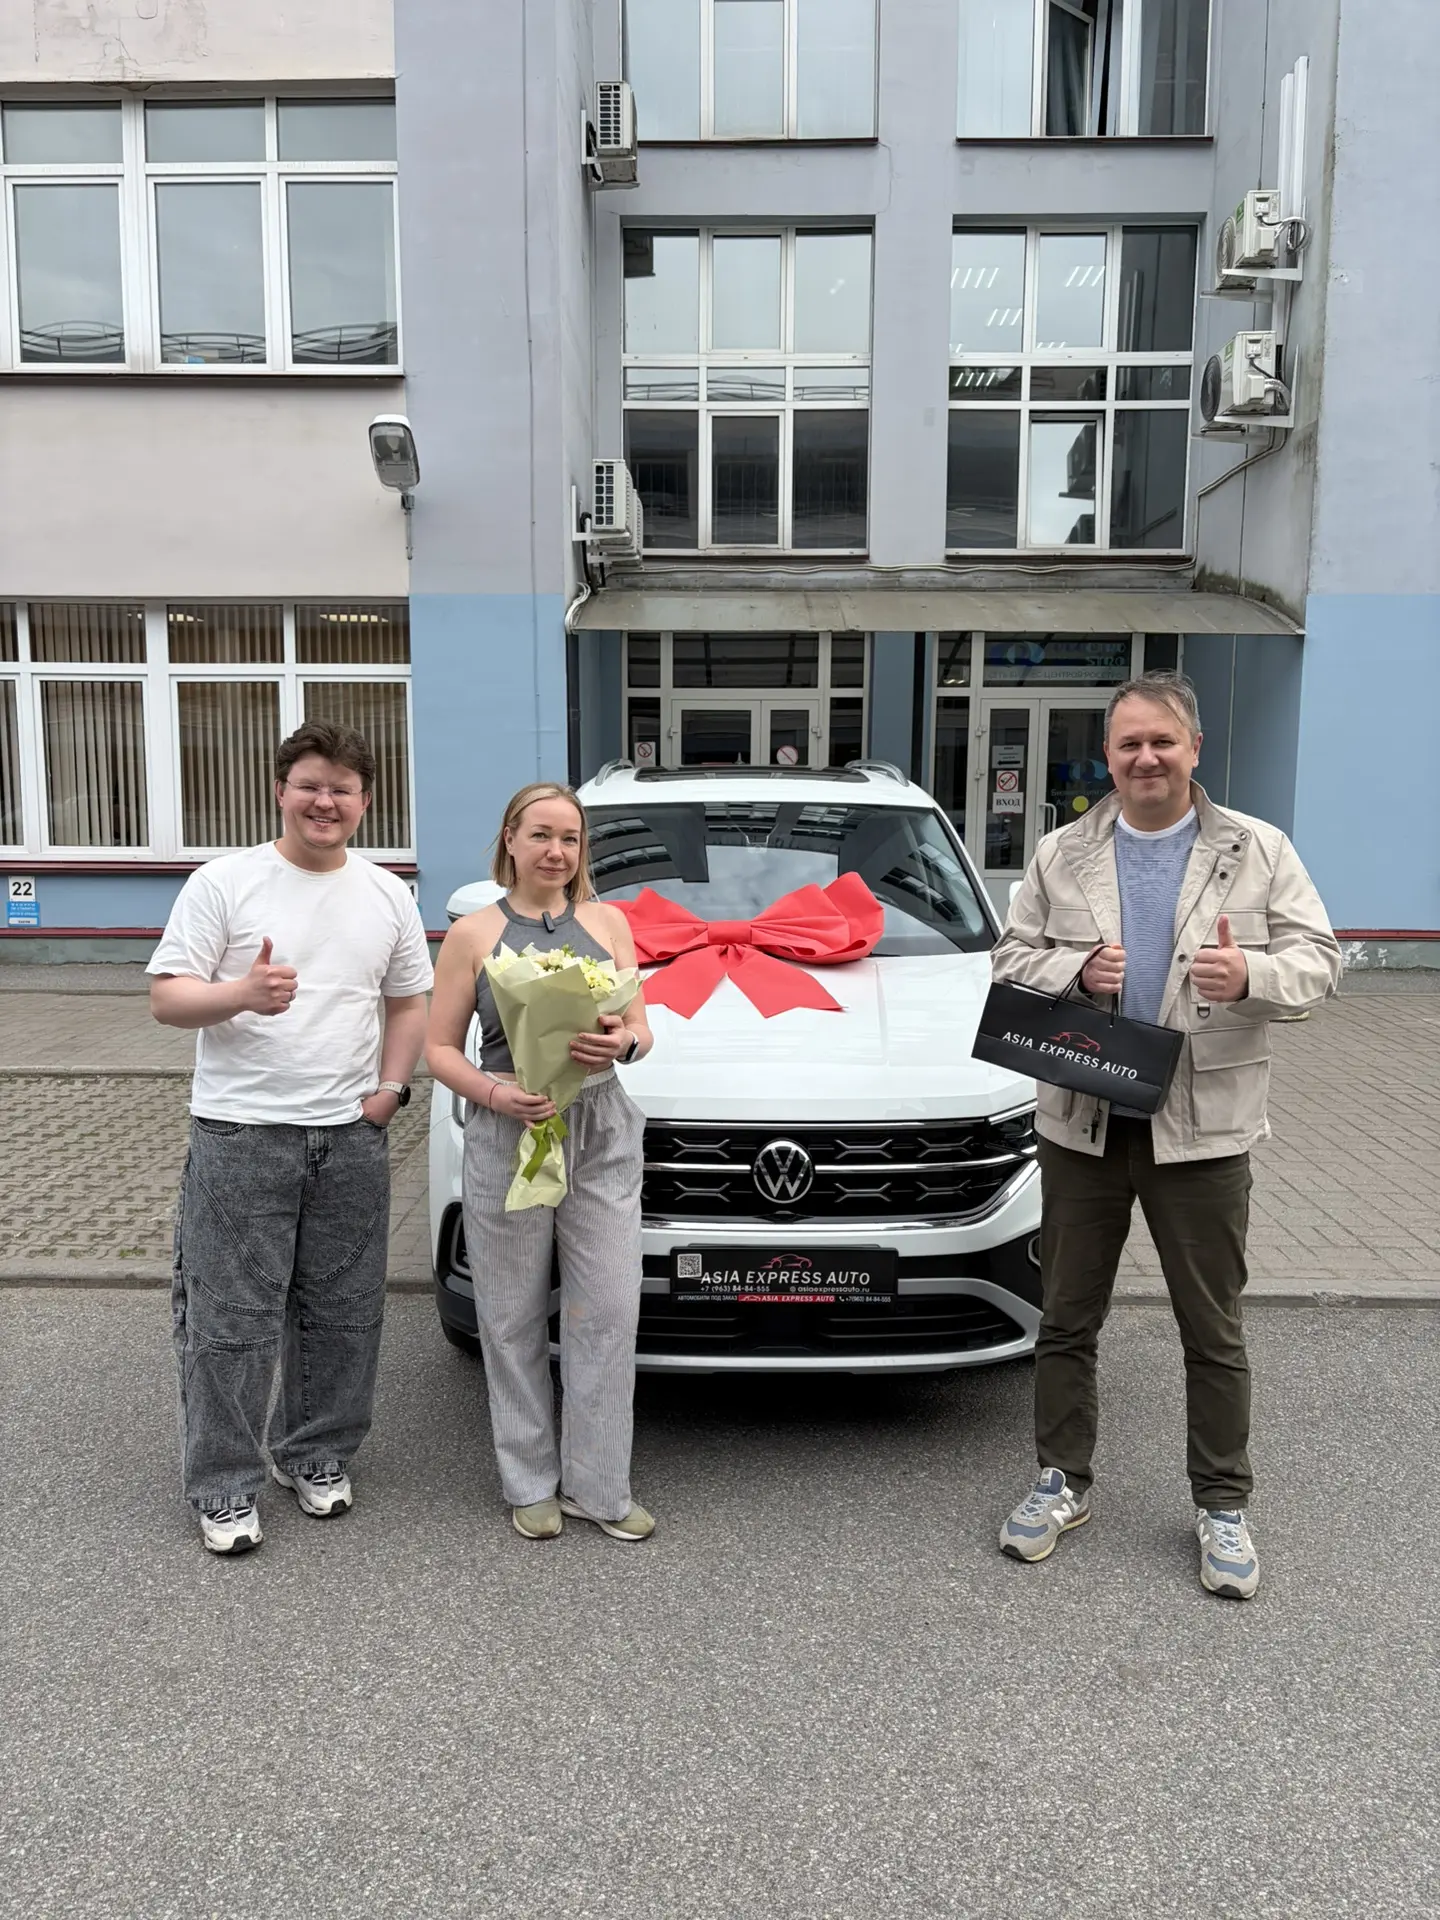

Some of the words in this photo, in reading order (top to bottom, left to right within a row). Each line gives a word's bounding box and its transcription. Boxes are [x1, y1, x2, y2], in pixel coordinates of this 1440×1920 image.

[996, 798, 1020, 807] ВХОД
[12, 882, 33, 896] 22
[1002, 1031, 1034, 1049] ASIA
[1038, 1042, 1100, 1068] EXPRESS
[1101, 1061, 1138, 1080] AUTO
[700, 1270, 740, 1284] ASIA
[745, 1270, 822, 1285] EXPRESS
[825, 1271, 871, 1285] AUTO
[711, 1285, 731, 1293] (963)
[797, 1285, 870, 1293] asiaexpressauto.ru
